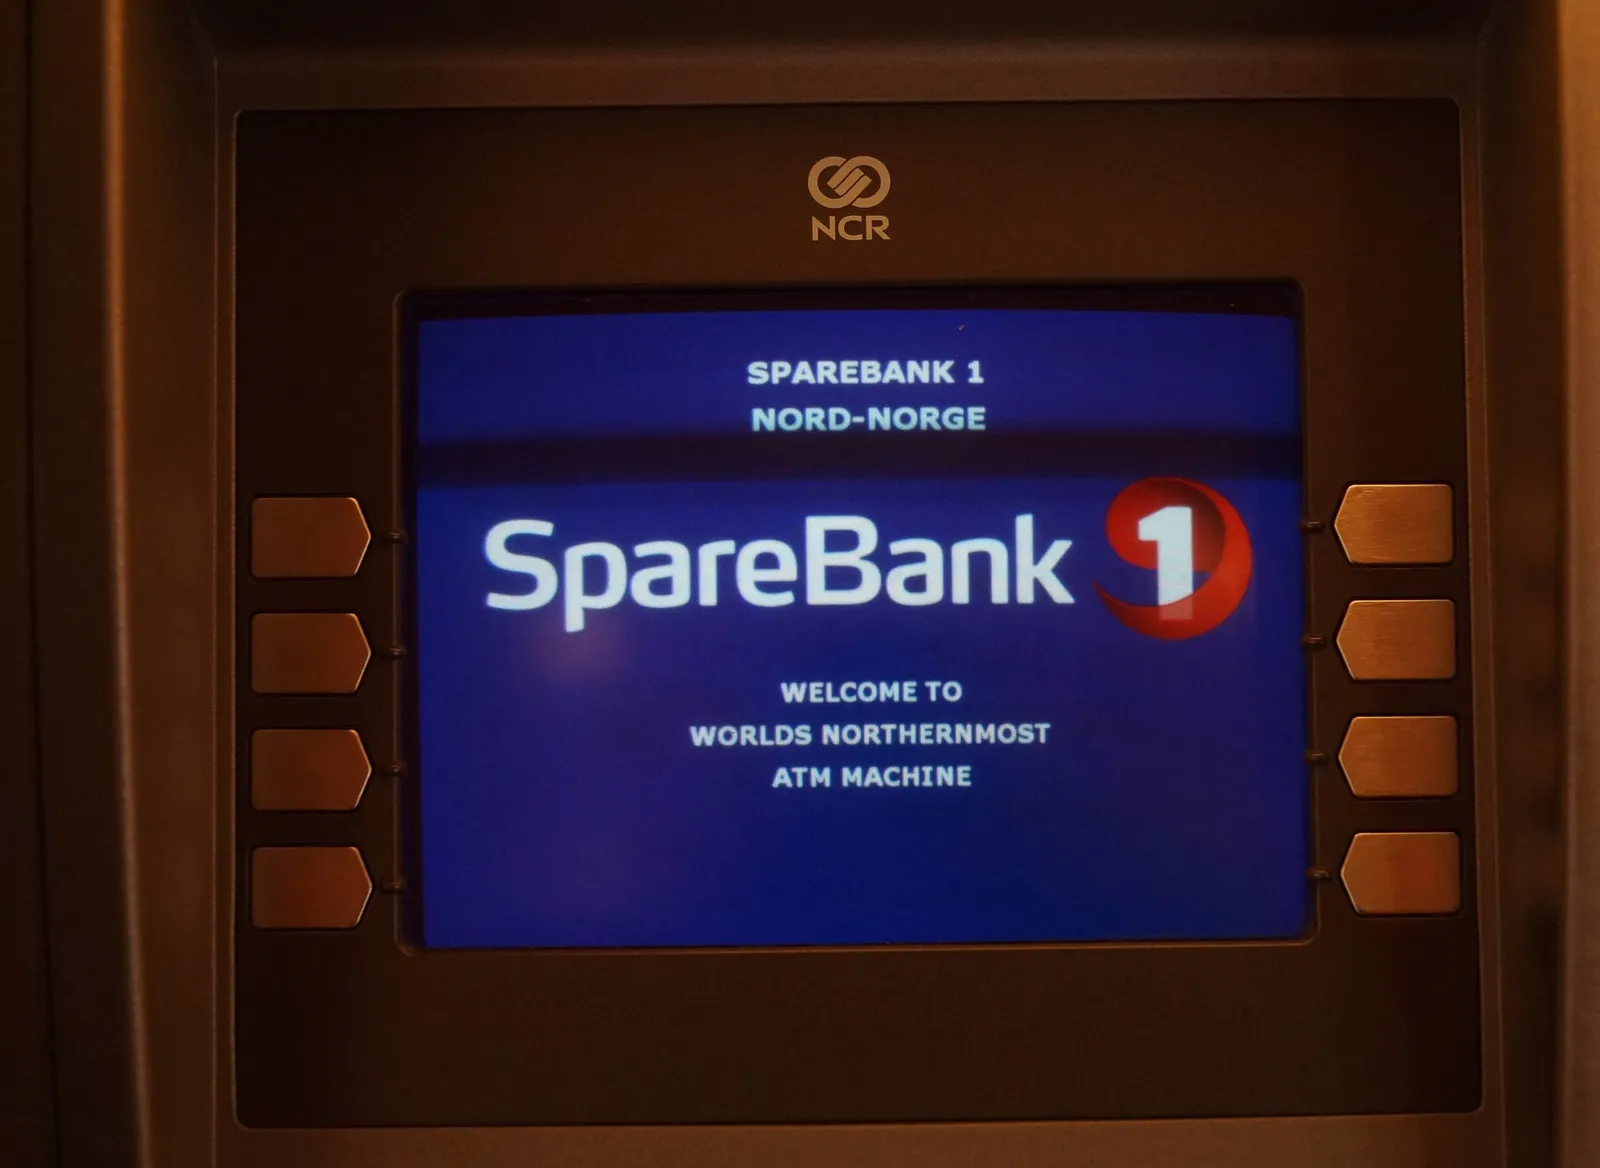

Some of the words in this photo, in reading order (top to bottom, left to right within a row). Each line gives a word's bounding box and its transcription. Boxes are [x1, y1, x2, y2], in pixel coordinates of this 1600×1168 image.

[811, 215, 891, 241] NCR
[747, 359, 956, 385] SPAREBANK
[967, 360, 985, 384] 1
[751, 406, 987, 432] NORD-NORGE
[484, 513, 1075, 633] SpareBank
[1137, 505, 1194, 620] 1
[780, 681, 918, 704] WELCOME
[924, 680, 963, 703] TO
[689, 724, 813, 747] WORLDS
[822, 722, 1051, 746] NORTHERNMOST
[771, 766, 832, 789] ATM
[841, 765, 973, 788] MACHINE
